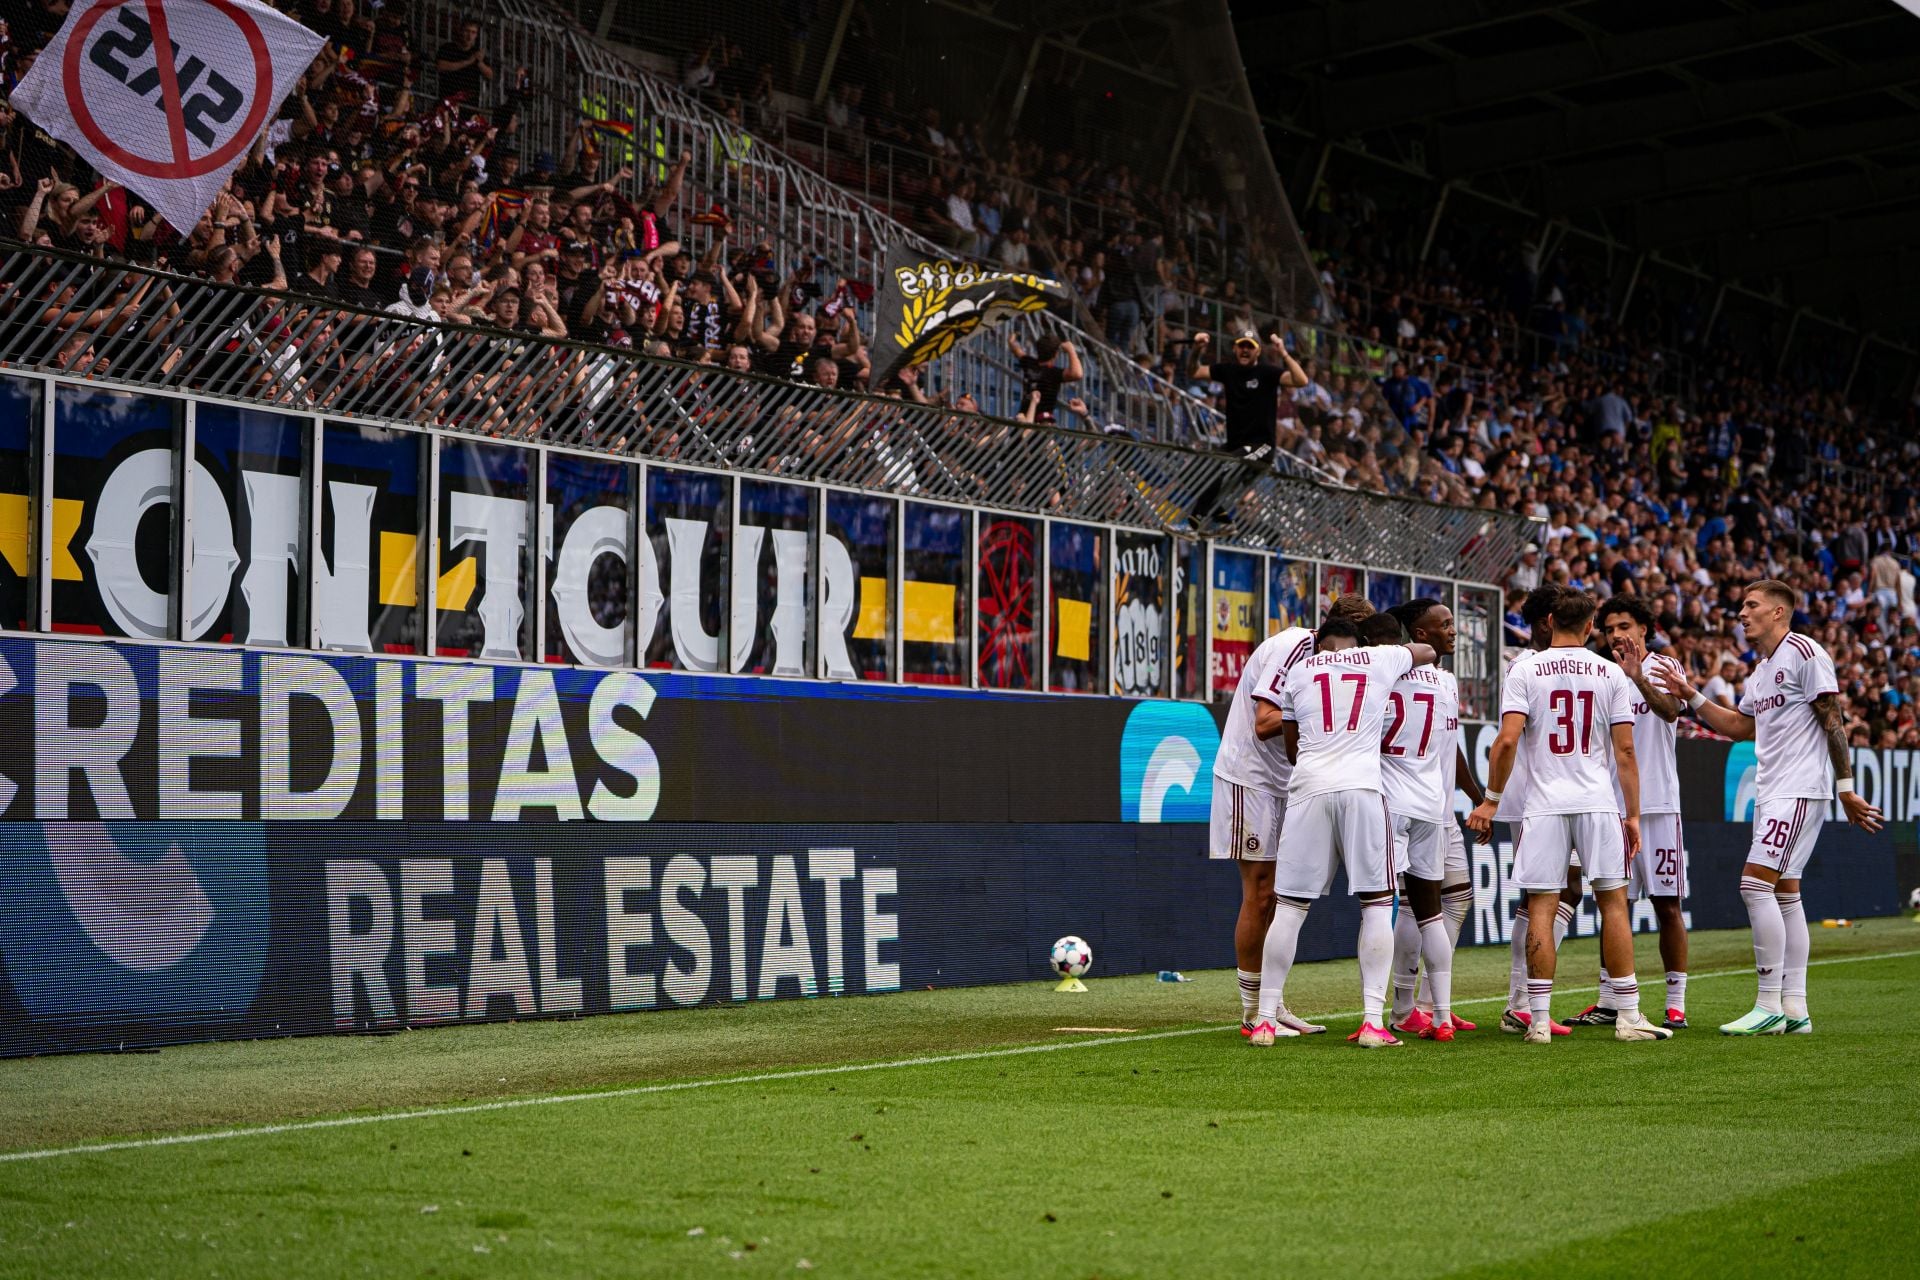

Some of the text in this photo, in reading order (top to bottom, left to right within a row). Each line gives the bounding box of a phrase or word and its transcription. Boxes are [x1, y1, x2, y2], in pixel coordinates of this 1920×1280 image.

[86, 448, 857, 680] ON TOUR
[1122, 631, 1161, 666] 189
[1534, 657, 1610, 679] JURÁSEK M.
[0, 641, 661, 821] REDITAS
[1313, 673, 1369, 735] 17
[1381, 691, 1436, 758] 27
[1549, 689, 1595, 757] 31
[1655, 848, 1677, 876] 25
[1762, 818, 1790, 849] 26
[325, 847, 900, 1029] REAL ESTATE
